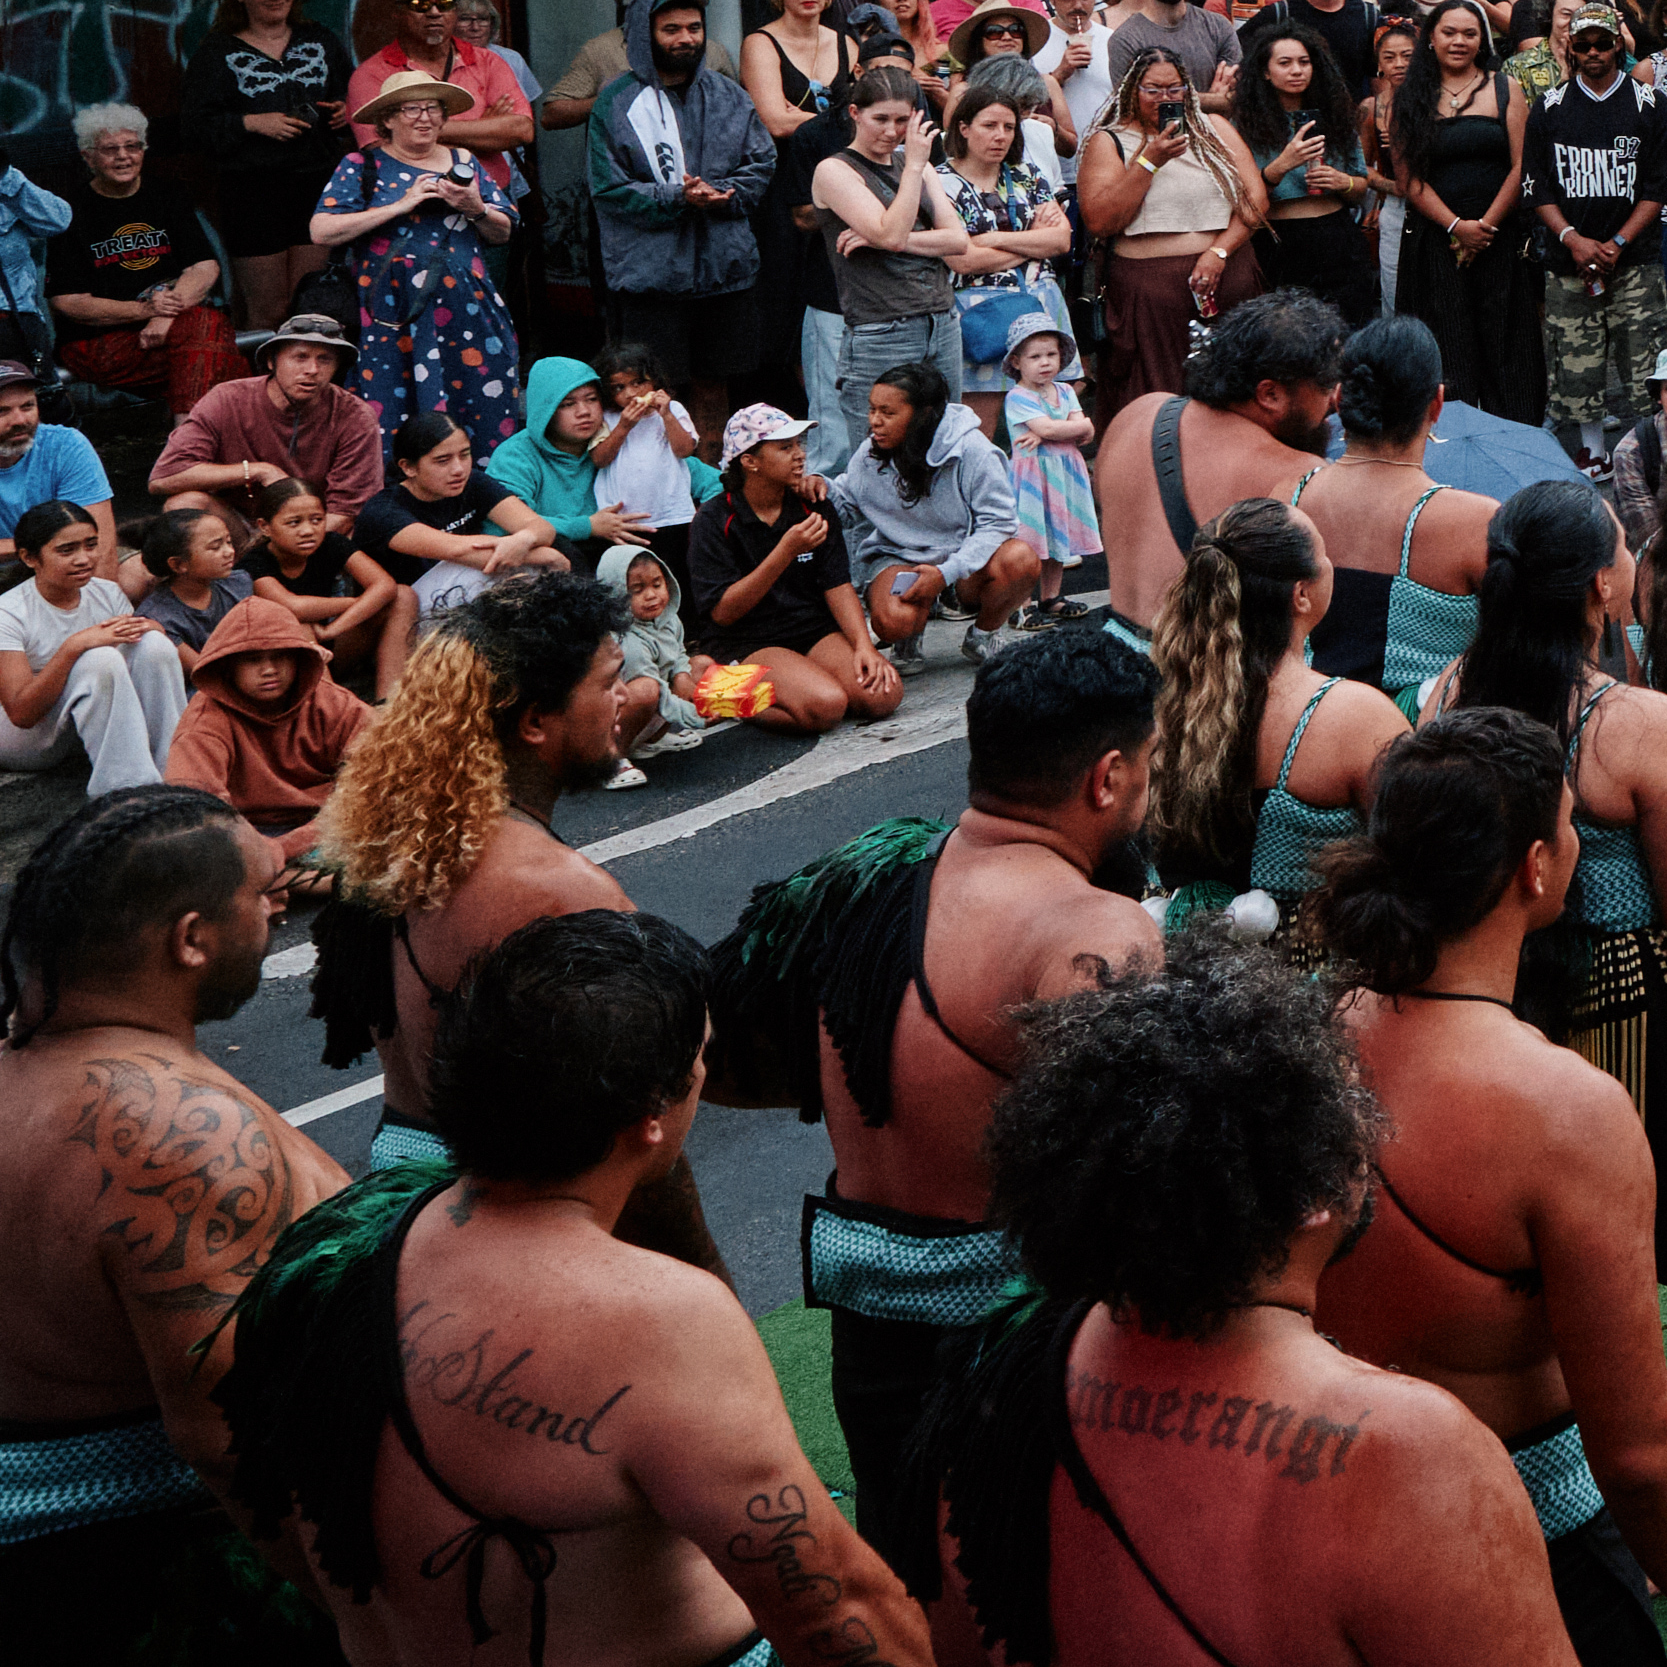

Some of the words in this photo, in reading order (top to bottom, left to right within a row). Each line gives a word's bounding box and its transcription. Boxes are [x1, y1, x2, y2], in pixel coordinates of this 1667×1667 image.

[1554, 140, 1619, 183] FRONT
[1612, 134, 1642, 159] 92
[1563, 161, 1638, 205] RUNNER
